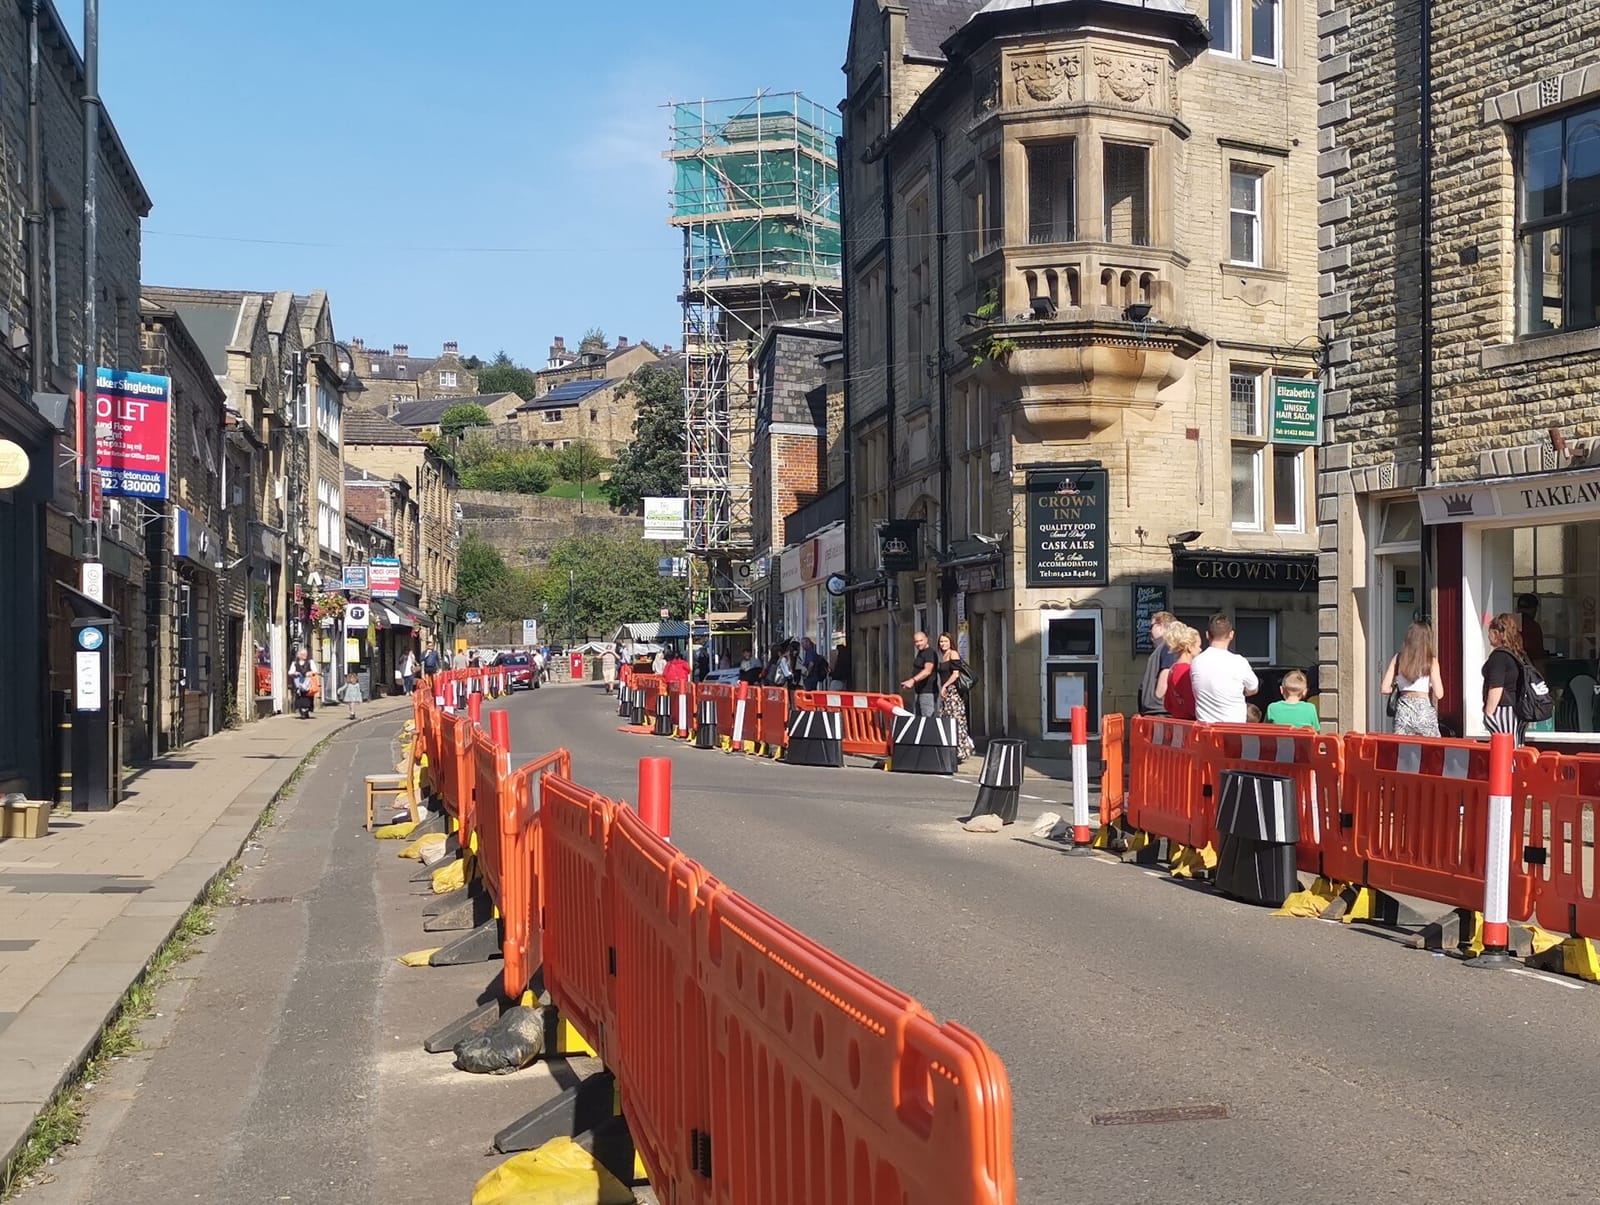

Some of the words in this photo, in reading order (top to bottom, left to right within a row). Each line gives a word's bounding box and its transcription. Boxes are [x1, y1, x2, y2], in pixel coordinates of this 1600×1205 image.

[97, 377, 163, 395] lkerSingleton
[1277, 386, 1315, 399] Elizabeth's
[97, 398, 112, 417] O
[117, 400, 149, 422] LET
[1283, 403, 1308, 412] UNISEX
[1276, 411, 1292, 419] HAIR
[1293, 412, 1315, 421] SALON
[113, 422, 133, 432] Floor
[121, 480, 160, 493] 430000
[1038, 495, 1096, 508] CROWN
[1053, 508, 1081, 520] INN
[1040, 524, 1073, 532] QUALITY
[1041, 541, 1067, 550] CASK
[1069, 540, 1095, 550] ALES
[1037, 560, 1098, 568] ACCOMMODATION
[1196, 560, 1278, 579] CROWN
[352, 609, 363, 617] FT
